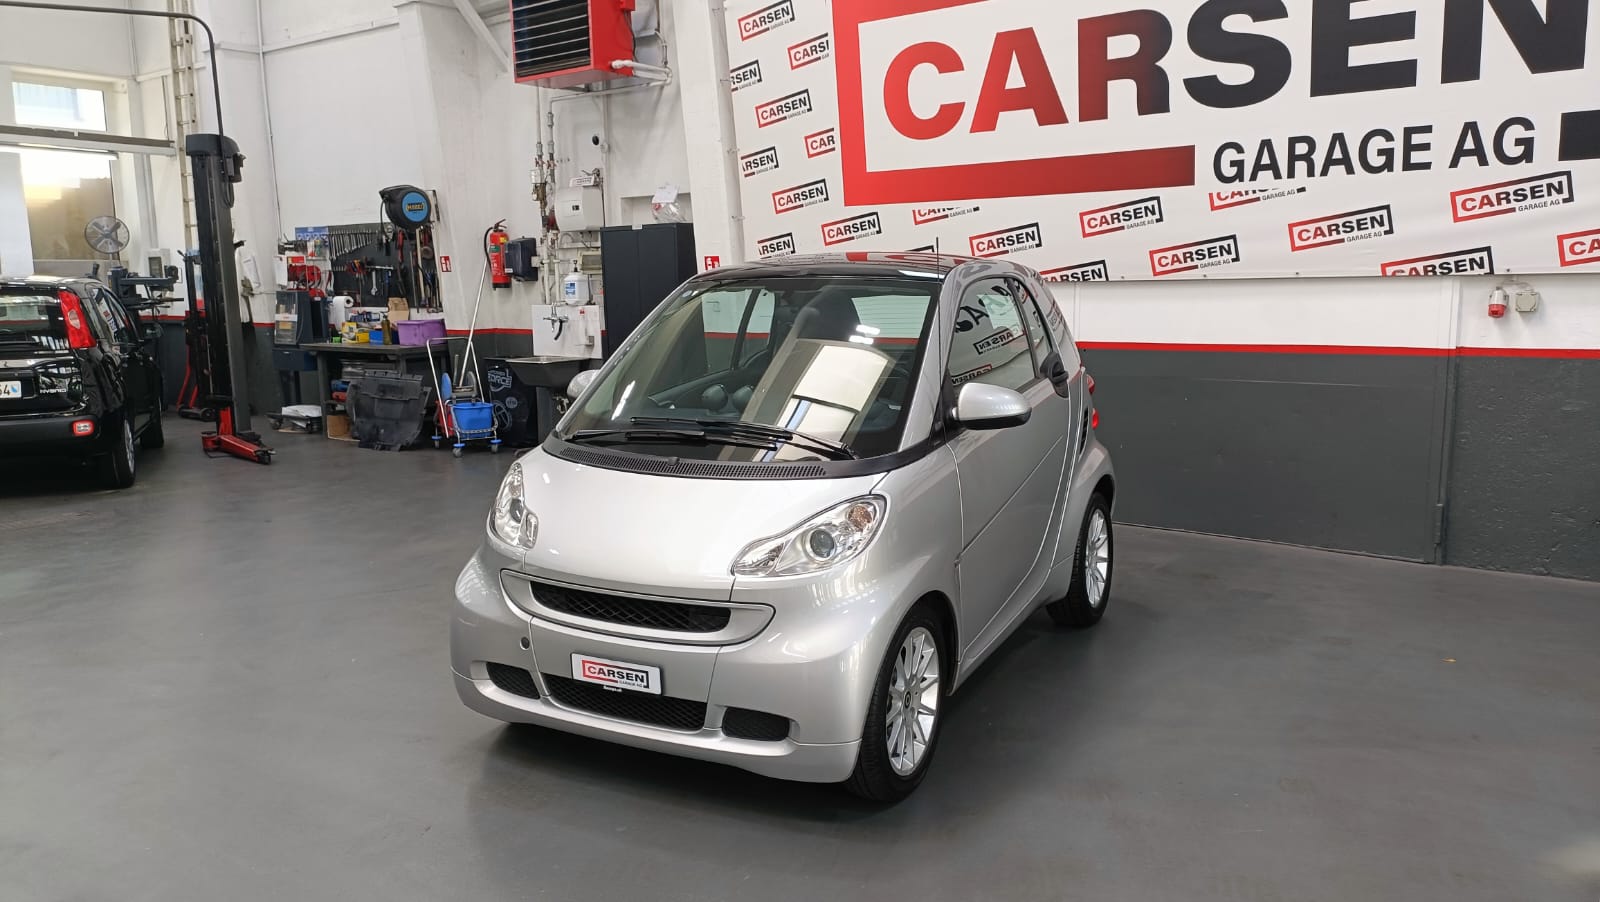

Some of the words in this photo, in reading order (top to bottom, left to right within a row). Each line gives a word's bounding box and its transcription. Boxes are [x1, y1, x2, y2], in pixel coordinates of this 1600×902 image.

[743, 5, 790, 33] CARSEN
[882, 0, 1590, 140] CARSEN
[760, 96, 808, 121] CARSEN
[1212, 124, 1433, 184] GARAGE
[1448, 116, 1536, 169] AG
[777, 185, 824, 208] CARSEN
[1262, 190, 1286, 201] GARAGE
[1286, 188, 1296, 196] AG
[1460, 180, 1564, 212] CARSEN
[1517, 200, 1548, 212] GARAGE
[1549, 198, 1560, 206] AG
[1086, 204, 1157, 229] CARSEN
[1297, 214, 1385, 242] CARSEN
[827, 218, 877, 240] CARSEN
[1346, 232, 1373, 243] GARAGE
[975, 230, 1037, 253] CARSEN
[1157, 243, 1233, 268] CARSEN
[1199, 260, 1222, 269] GARAGE
[587, 665, 645, 683] CARSEN
